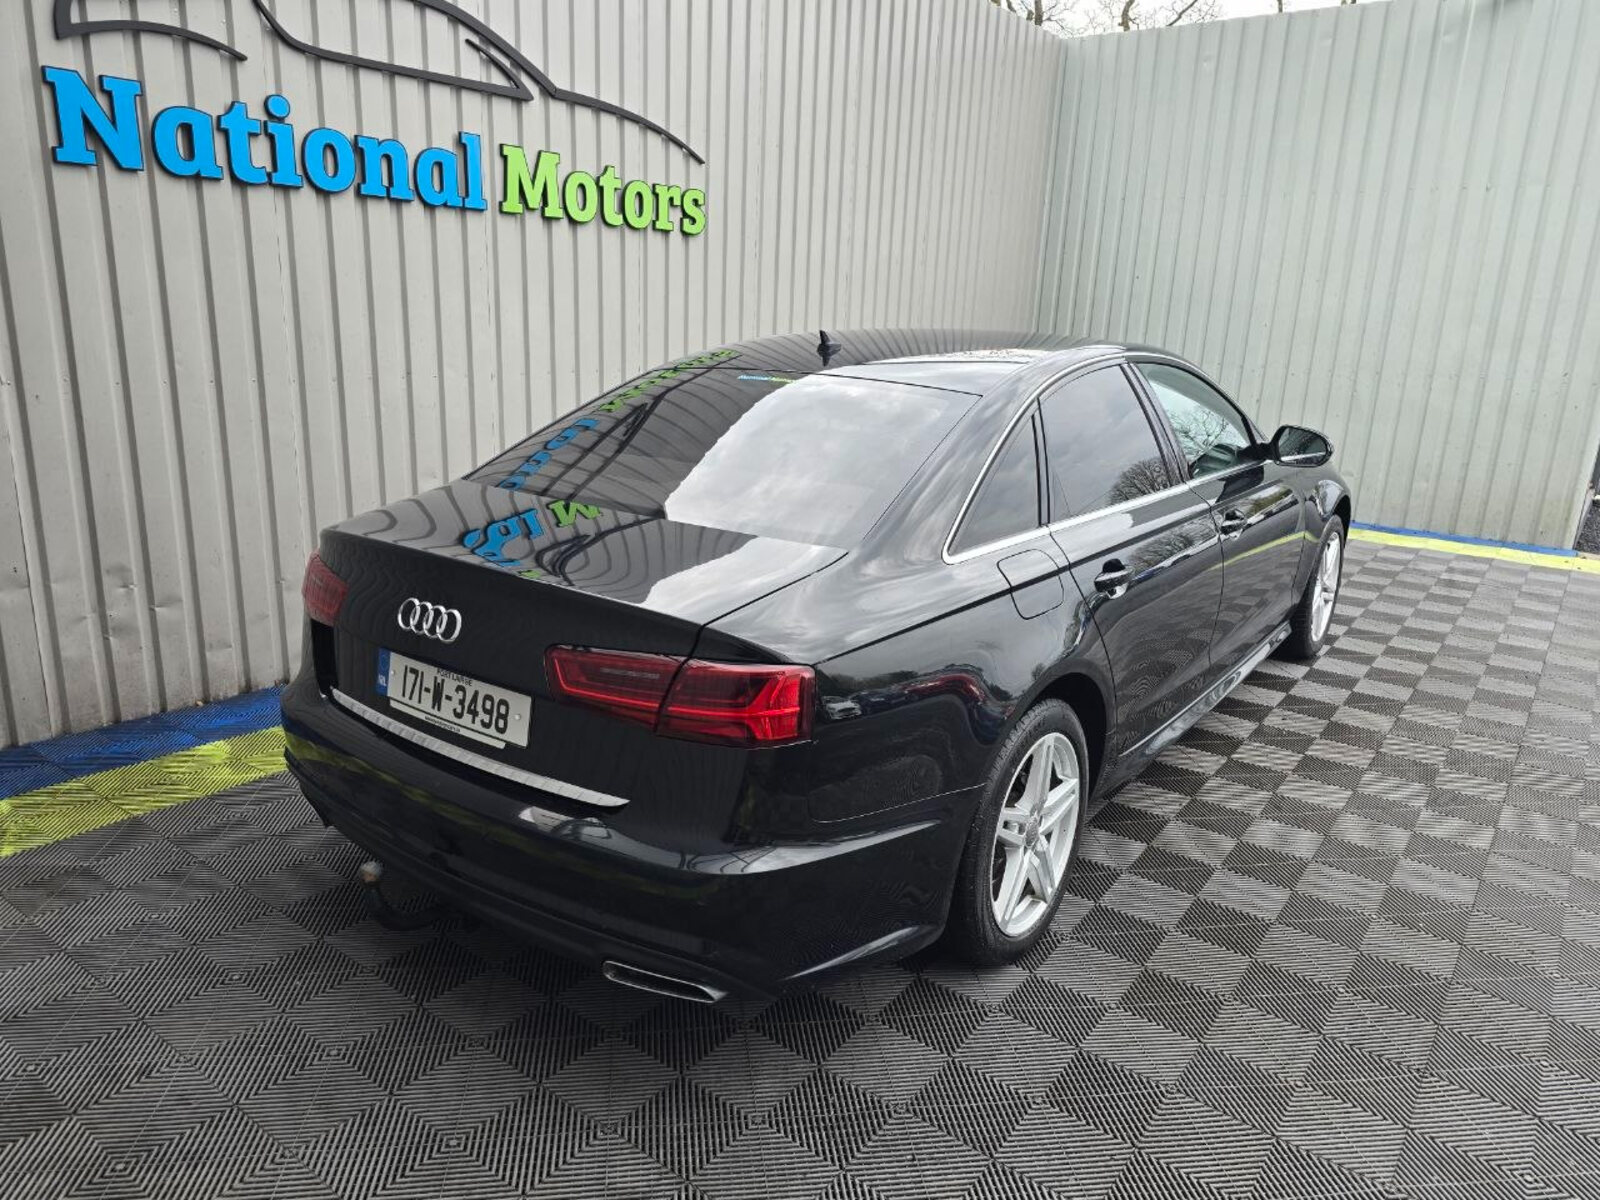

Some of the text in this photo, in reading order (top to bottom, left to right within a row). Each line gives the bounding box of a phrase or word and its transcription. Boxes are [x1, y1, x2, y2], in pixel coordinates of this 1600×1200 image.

[41, 65, 706, 236] National Motors
[401, 664, 510, 735] 171-W-3498
